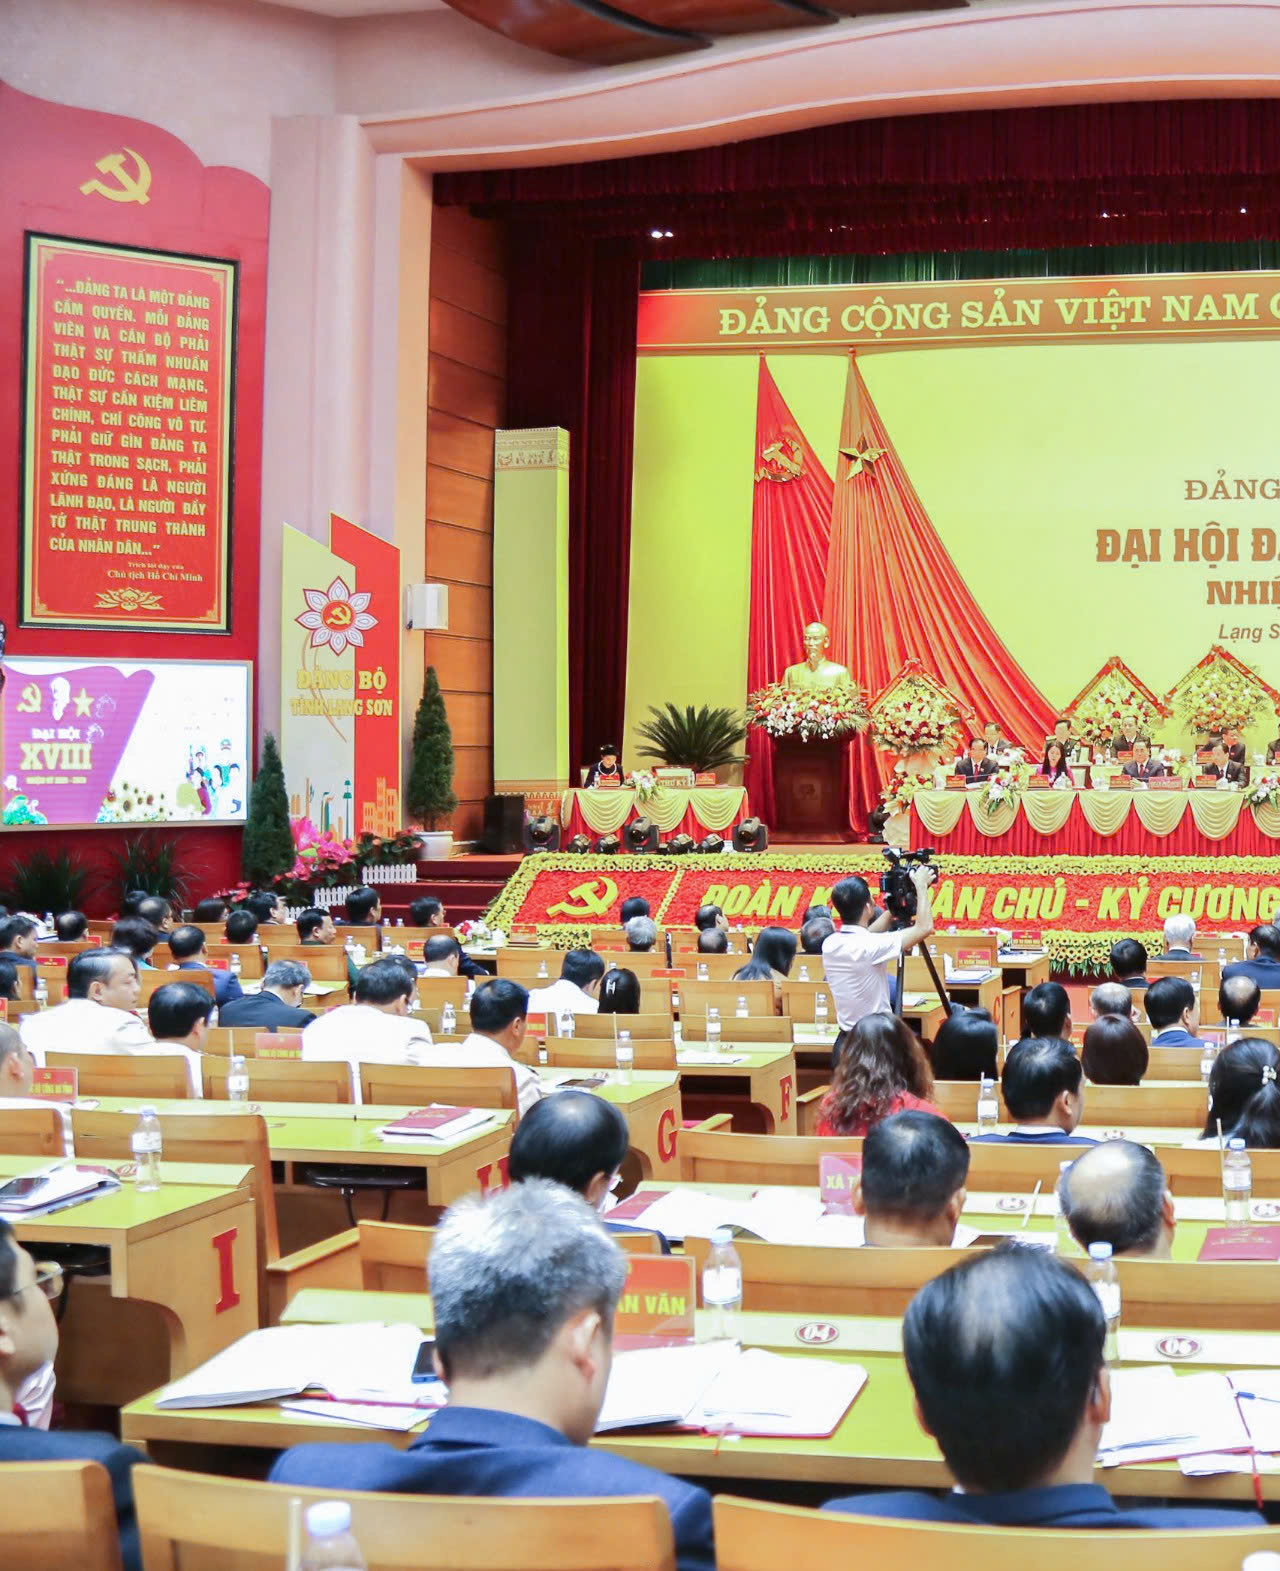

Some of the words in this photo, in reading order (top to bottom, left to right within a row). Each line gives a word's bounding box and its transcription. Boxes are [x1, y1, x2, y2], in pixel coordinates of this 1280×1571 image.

[177, 312, 209, 330] ĐẢNG
[720, 296, 831, 334] ĐẢNG
[841, 296, 951, 338] CỘNG
[961, 288, 1043, 328] SẢN
[1054, 288, 1151, 330] VIỆT
[1162, 293, 1259, 322] NAM
[54, 321, 84, 337] VIÊN
[94, 326, 109, 340] VÀ
[119, 329, 145, 344] CÁN
[155, 332, 171, 349] BỘ
[180, 334, 208, 351] PHẢI
[54, 343, 85, 360] THẬT
[95, 348, 113, 363] SỰ
[53, 365, 79, 381] ĐẠO
[89, 366, 114, 382] ĐỨC
[125, 371, 158, 387] CÁCH
[167, 376, 207, 393] MẠNG,
[53, 386, 83, 402] THẬT
[89, 390, 107, 405] SỰ
[143, 394, 173, 411] KIỆM
[180, 397, 207, 412] LIÊM
[52, 407, 94, 424] CHÍNH,
[101, 412, 121, 425] CHÍ
[129, 413, 161, 429] CÔNG
[168, 417, 183, 431] VÔ
[52, 426, 81, 443] PHẢI
[91, 431, 113, 446] GIỮ
[121, 434, 142, 448] GÌN
[151, 434, 184, 452] ĐẢNG
[193, 441, 206, 453] TA
[52, 450, 81, 466] THẬT
[89, 454, 129, 468] TRONG
[137, 457, 171, 472] SẠCH,
[179, 457, 206, 474] PHẢI
[52, 470, 87, 486] XỨNG
[97, 474, 133, 489] ĐÁNG
[143, 477, 158, 491] LÀ
[167, 480, 206, 494] NGƯỜI
[51, 492, 83, 507] LÃNH
[87, 496, 115, 511] ĐẠO,
[120, 497, 134, 510] LÀ
[139, 498, 174, 513] NGƯỜI
[51, 513, 66, 528] TỚ
[76, 516, 106, 532] THẬT
[116, 519, 156, 533] TRUNG
[166, 521, 205, 536] THÀNH
[50, 533, 74, 551] CỦA
[78, 538, 113, 553] NHÂN
[1096, 529, 1161, 568] ĐẠI
[1174, 521, 1239, 568] HỘI
[1219, 624, 1262, 643] Lạng
[359, 666, 387, 694] BỘ
[366, 698, 393, 716] SƠN
[20, 742, 92, 770] XVIII
[701, 879, 802, 917] ĐOÀN
[925, 879, 985, 919] ÂN
[992, 877, 1067, 920] CHỦ
[1097, 876, 1150, 920] KỶ
[780, 1075, 792, 1121] F
[657, 1107, 679, 1164] G
[211, 1227, 241, 1314] I
[645, 1292, 686, 1316] VĂN
